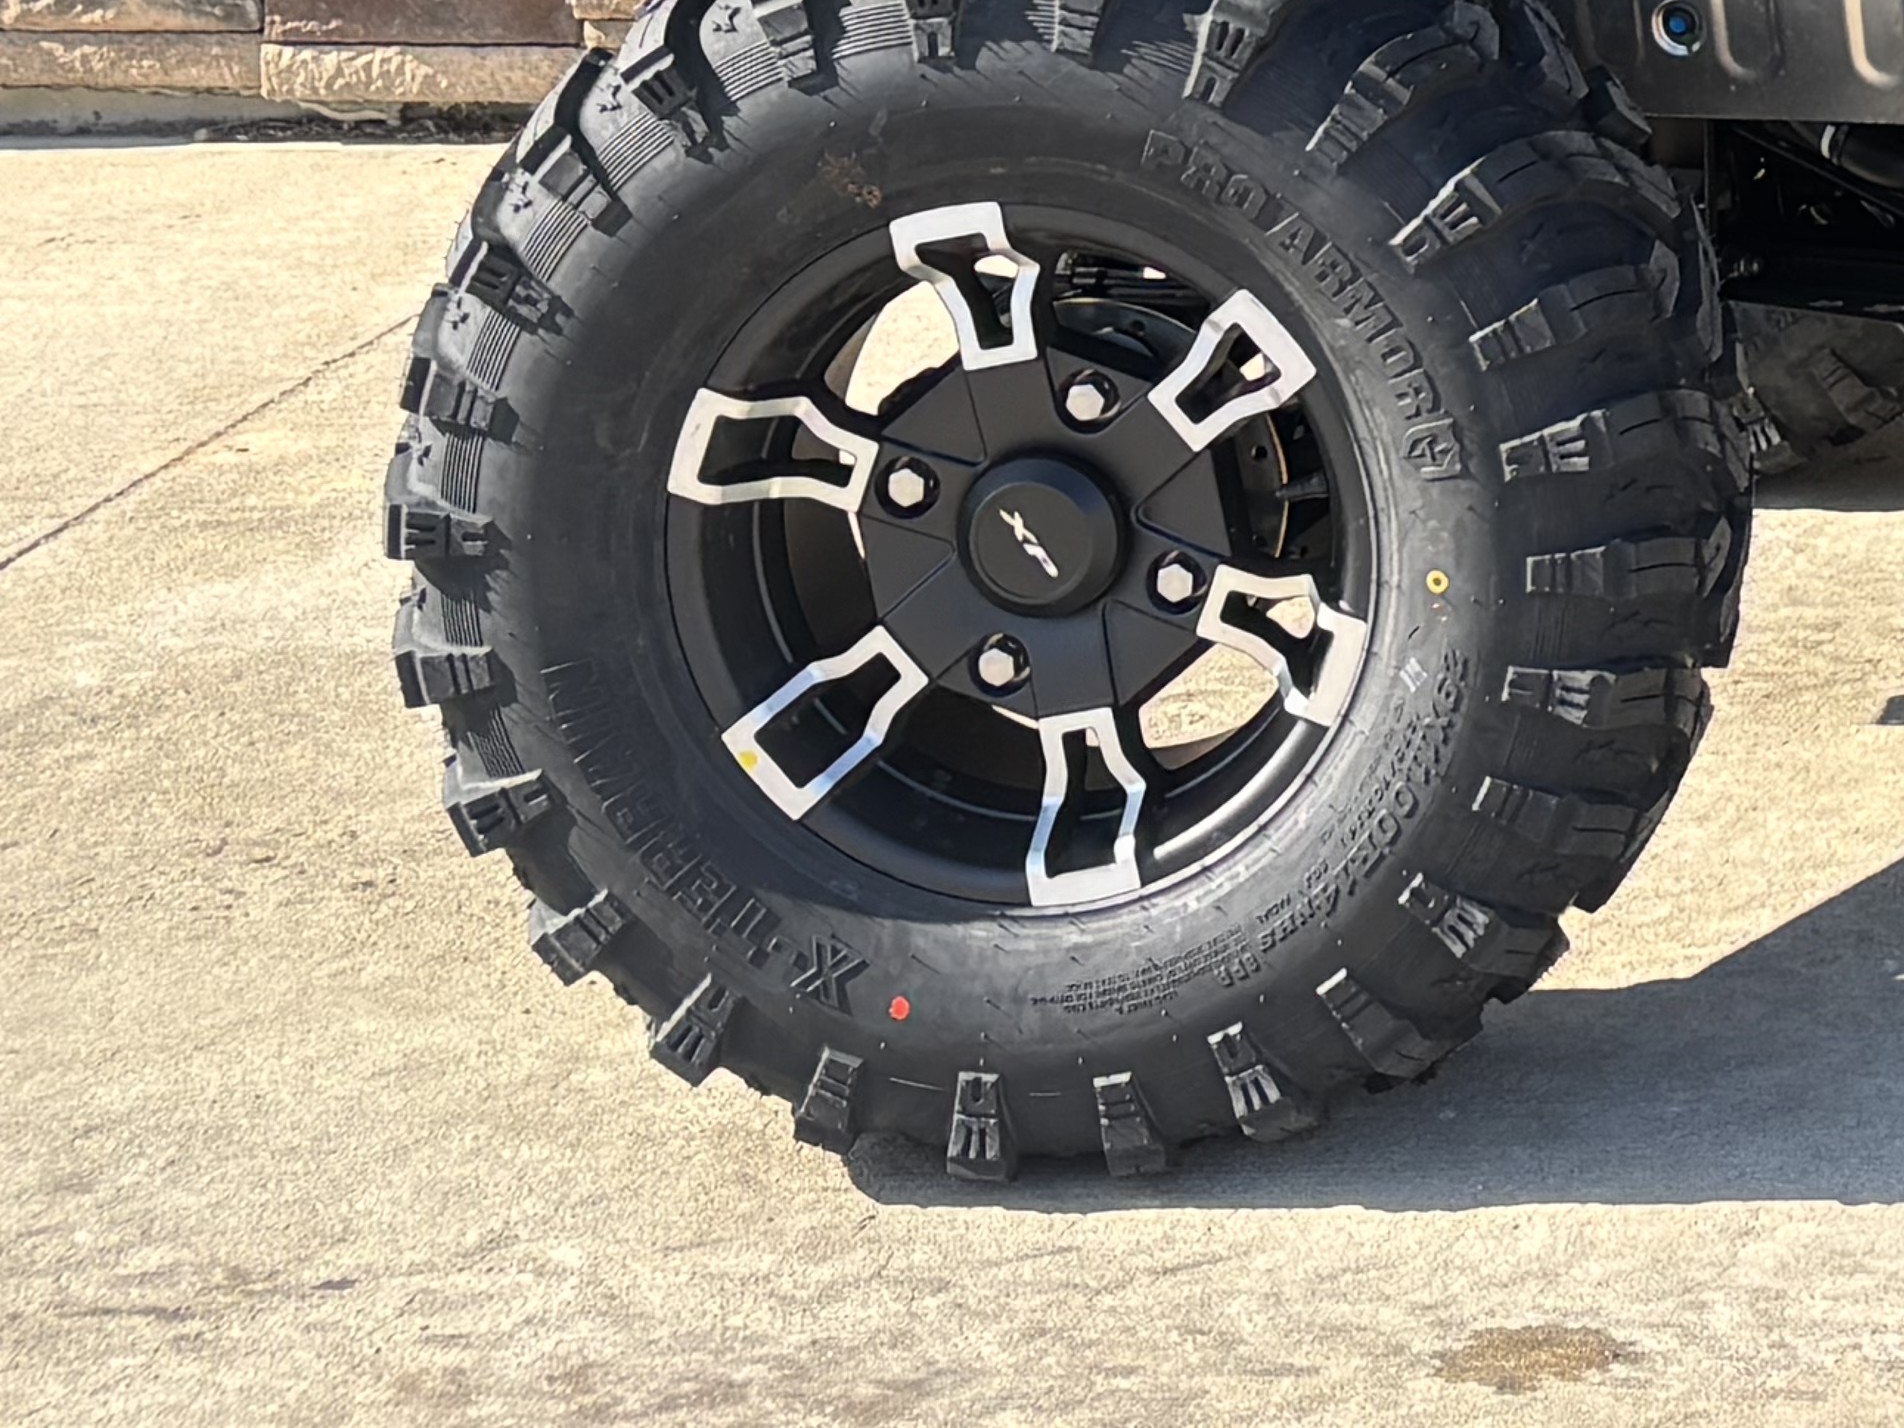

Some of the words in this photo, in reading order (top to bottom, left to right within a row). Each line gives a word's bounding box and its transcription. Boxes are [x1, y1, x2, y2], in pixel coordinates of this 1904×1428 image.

[1141, 130, 1270, 220] PRO
[1265, 211, 1447, 420] ARMOR
[999, 508, 1059, 578] XP
